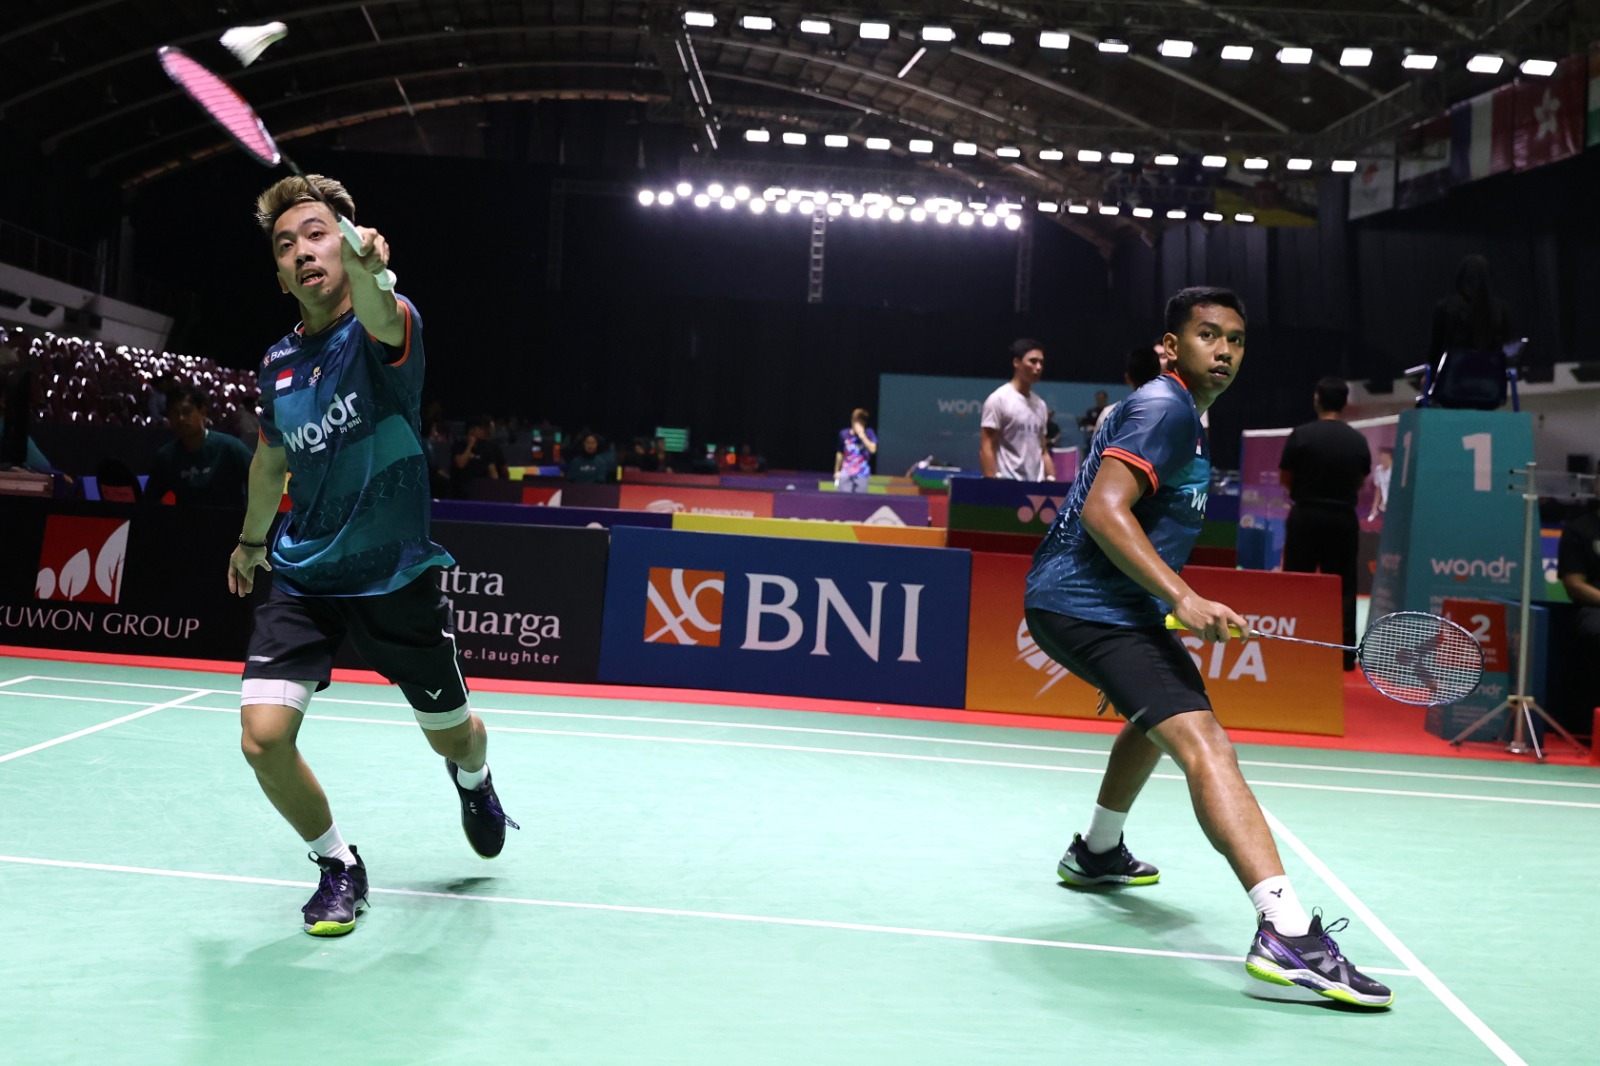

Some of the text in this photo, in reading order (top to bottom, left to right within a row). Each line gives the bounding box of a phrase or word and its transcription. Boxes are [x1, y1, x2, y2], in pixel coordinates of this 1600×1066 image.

[270, 348, 297, 362] BNI
[937, 398, 982, 417] won
[284, 393, 357, 453] wondr
[348, 418, 362, 429] BNI
[1462, 433, 1492, 491] 1
[439, 565, 505, 597] itra
[1430, 556, 1518, 581] wondr
[102, 612, 200, 639] GROUP
[739, 572, 925, 663] BNI
[1242, 613, 1297, 637] TON
[1469, 613, 1492, 643] 2
[458, 649, 560, 666] e.laughter
[1181, 636, 1268, 682] SIA
